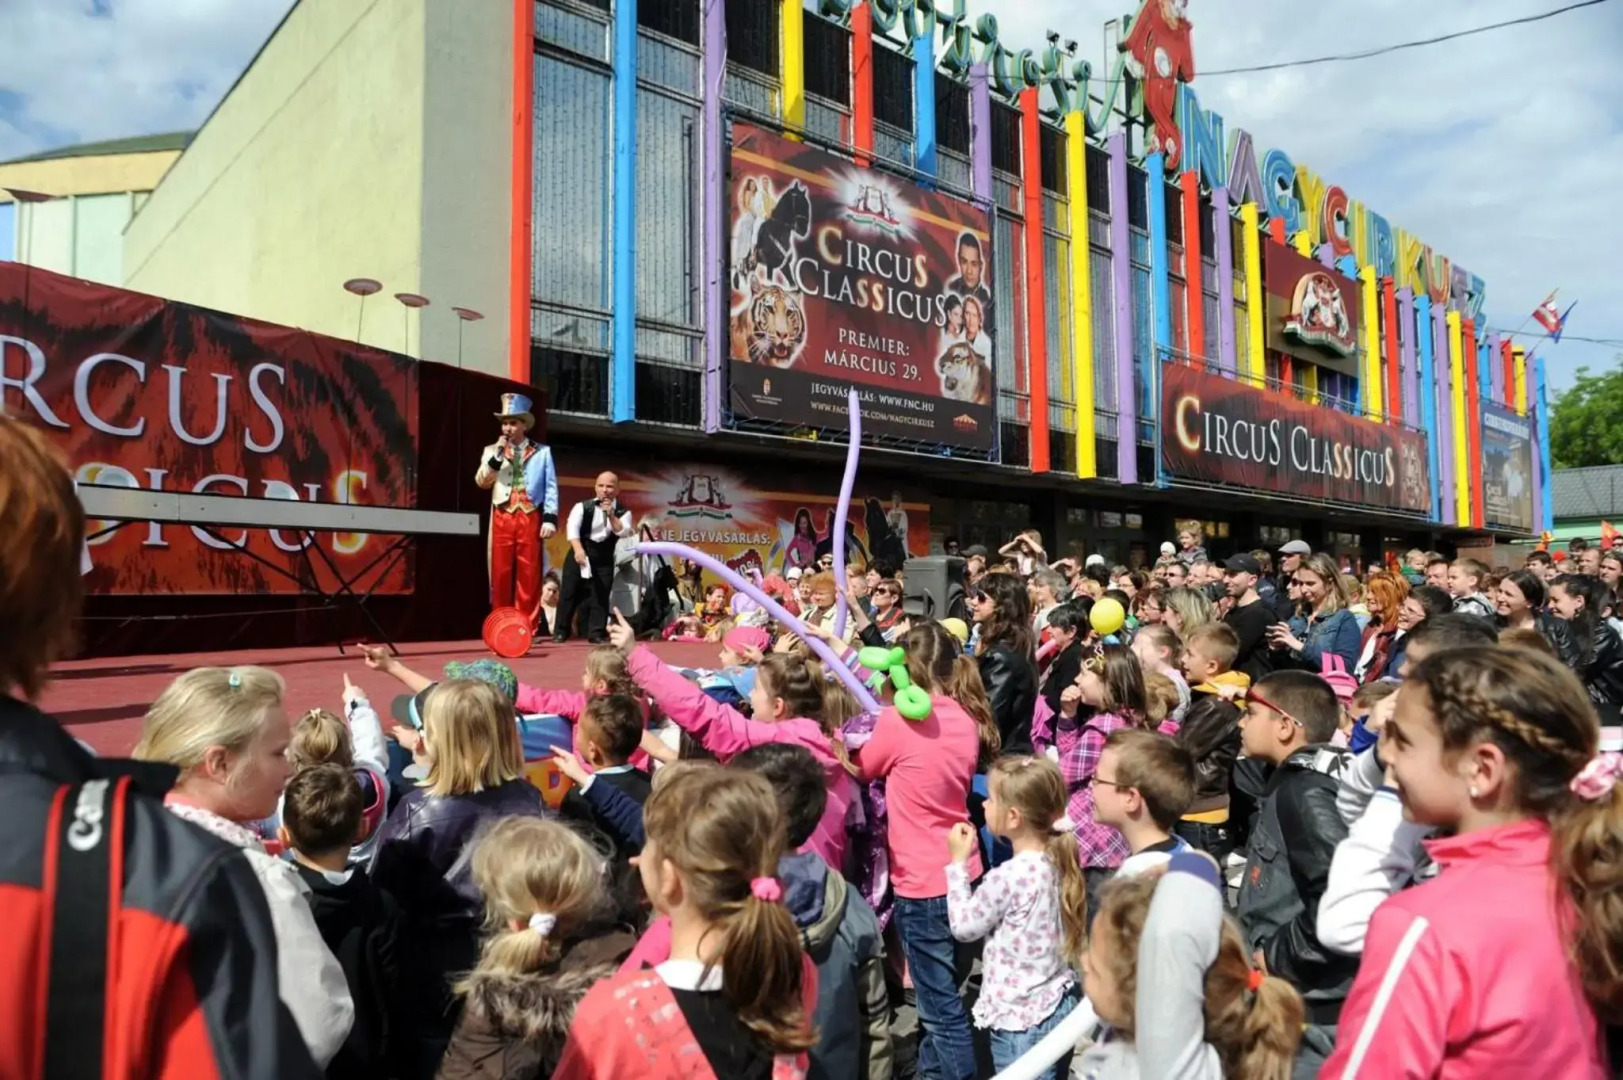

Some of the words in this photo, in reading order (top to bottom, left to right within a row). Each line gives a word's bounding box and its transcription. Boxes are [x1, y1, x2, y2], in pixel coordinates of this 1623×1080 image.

[817, 225, 928, 288] CIRCUS
[795, 257, 946, 326] CLASSICUS
[823, 349, 896, 376] MÁRCIUS
[902, 363, 922, 381] 29.
[838, 327, 910, 356] PREMIER:
[0, 333, 286, 454] RCUS
[879, 394, 935, 412] WWW.FNC.HU
[1175, 395, 1281, 466] CIRCUS
[1291, 425, 1395, 487] CLASSICUS
